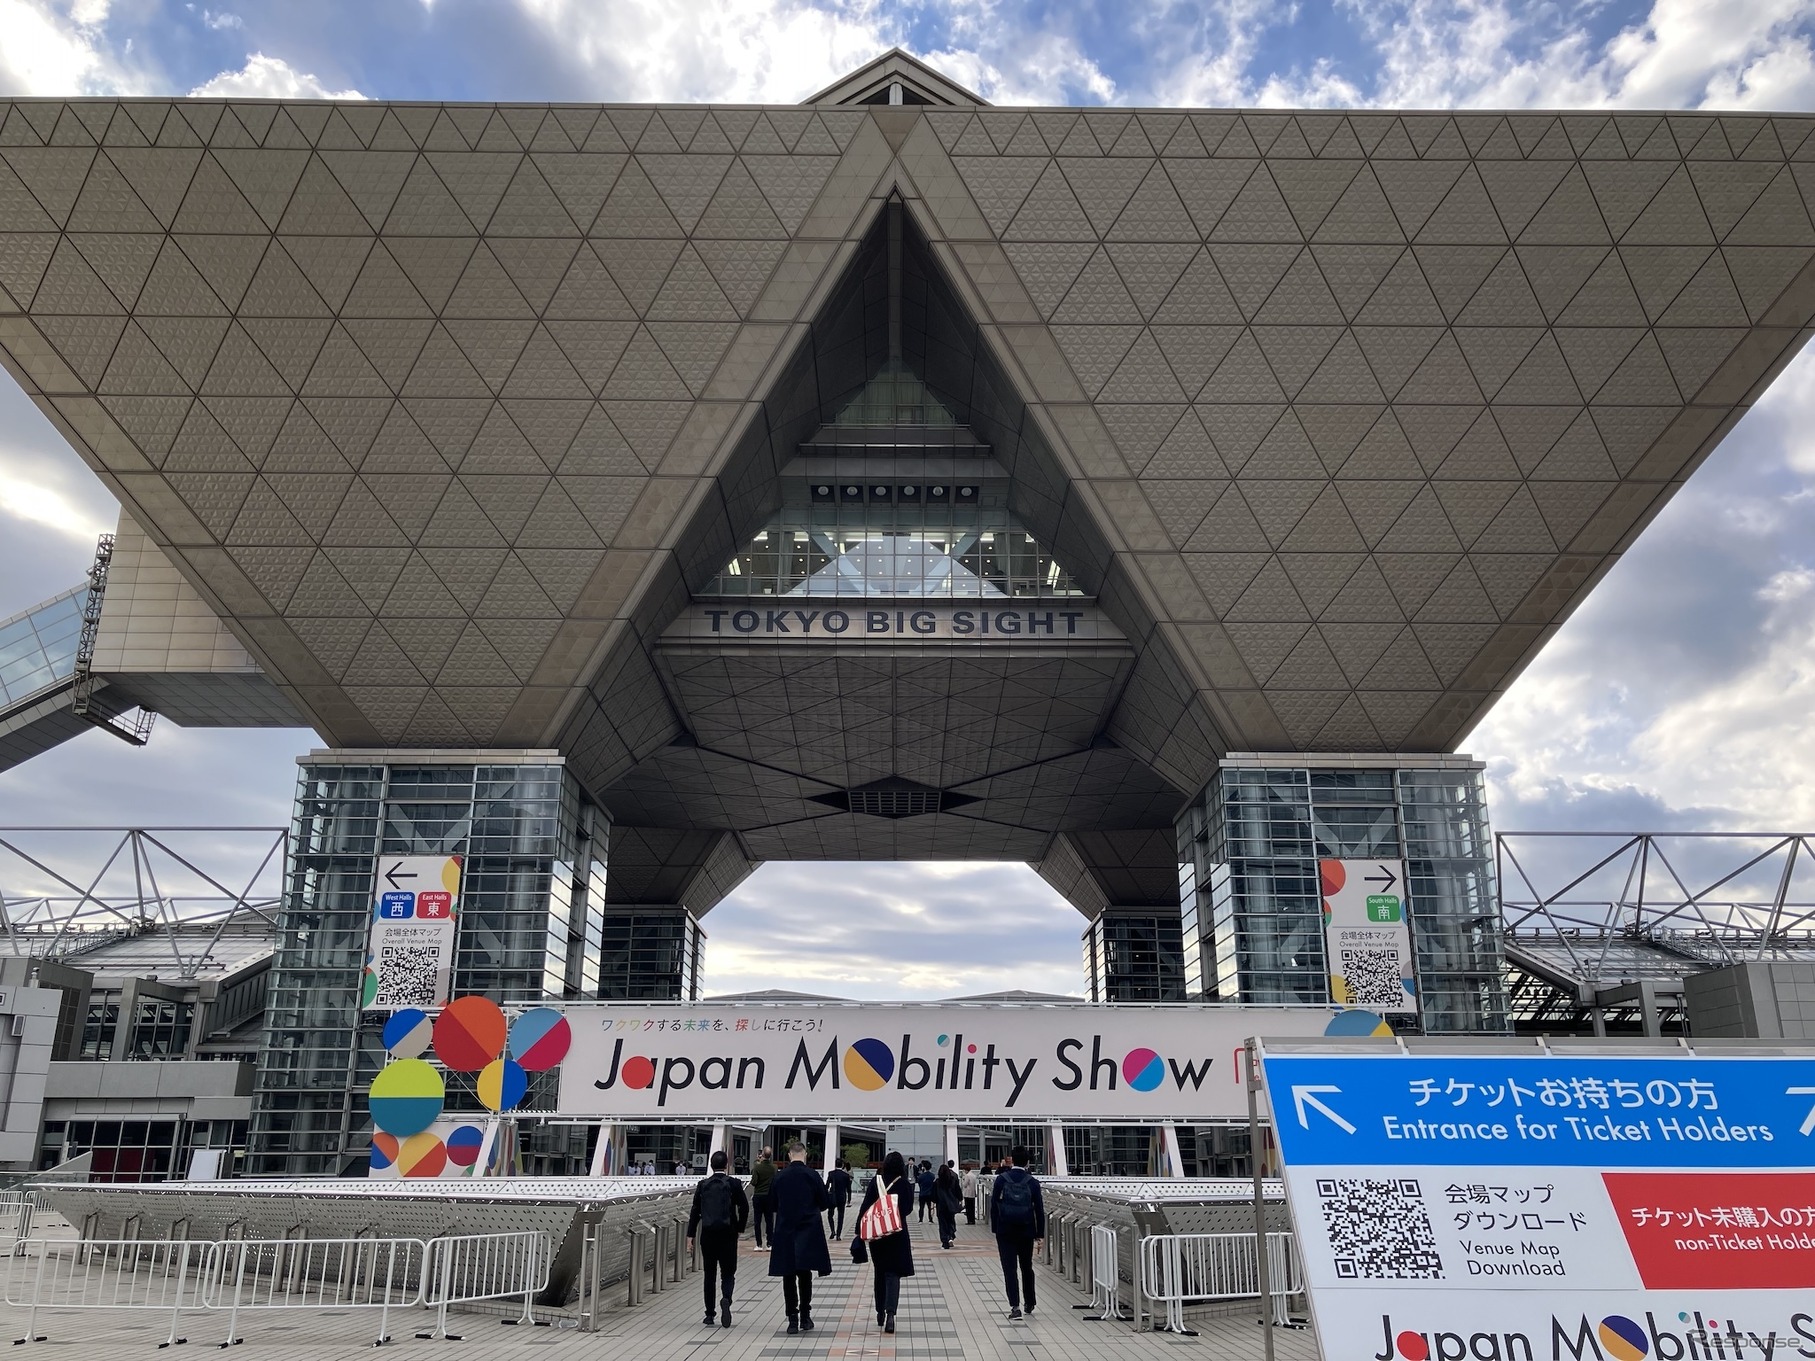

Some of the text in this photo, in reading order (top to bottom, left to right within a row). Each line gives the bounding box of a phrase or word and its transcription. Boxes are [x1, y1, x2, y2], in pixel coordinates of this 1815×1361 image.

[704, 610, 1084, 634] TOKYO BIG SIGHT
[391, 902, 404, 916] 西
[427, 902, 440, 916] 東
[1378, 905, 1390, 919] 南
[385, 928, 441, 937] 会場全体マップ
[1340, 931, 1396, 940] 会場全体マップ
[593, 1034, 1214, 1108] Japan Mobility Show
[1409, 1077, 1718, 1110] チケットお持ちの方
[1382, 1114, 1774, 1141] Entrance for Ticket Holders
[1444, 1183, 1555, 1204] 会場マップ
[1453, 1210, 1587, 1232] ダウンロード
[1459, 1240, 1560, 1259] Venue Map
[1674, 1233, 1764, 1250] non-Ticket
[1467, 1260, 1566, 1276] Download
